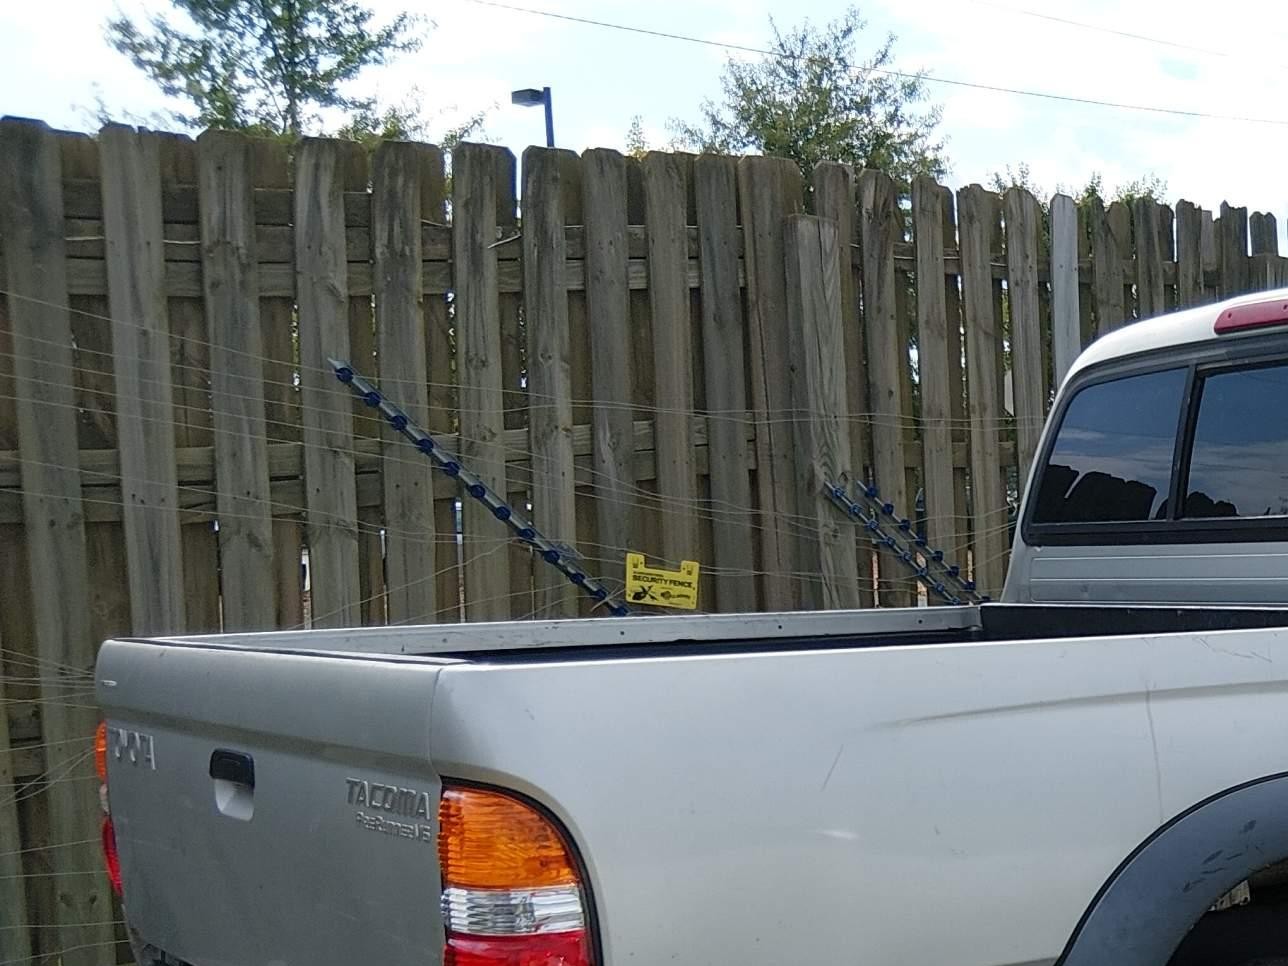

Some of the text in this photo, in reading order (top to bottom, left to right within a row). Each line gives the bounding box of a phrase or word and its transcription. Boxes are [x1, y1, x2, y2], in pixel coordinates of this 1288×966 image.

[632, 574, 669, 586] SECURITY
[669, 579, 693, 588] FENCE
[345, 776, 432, 820] TACOMA
